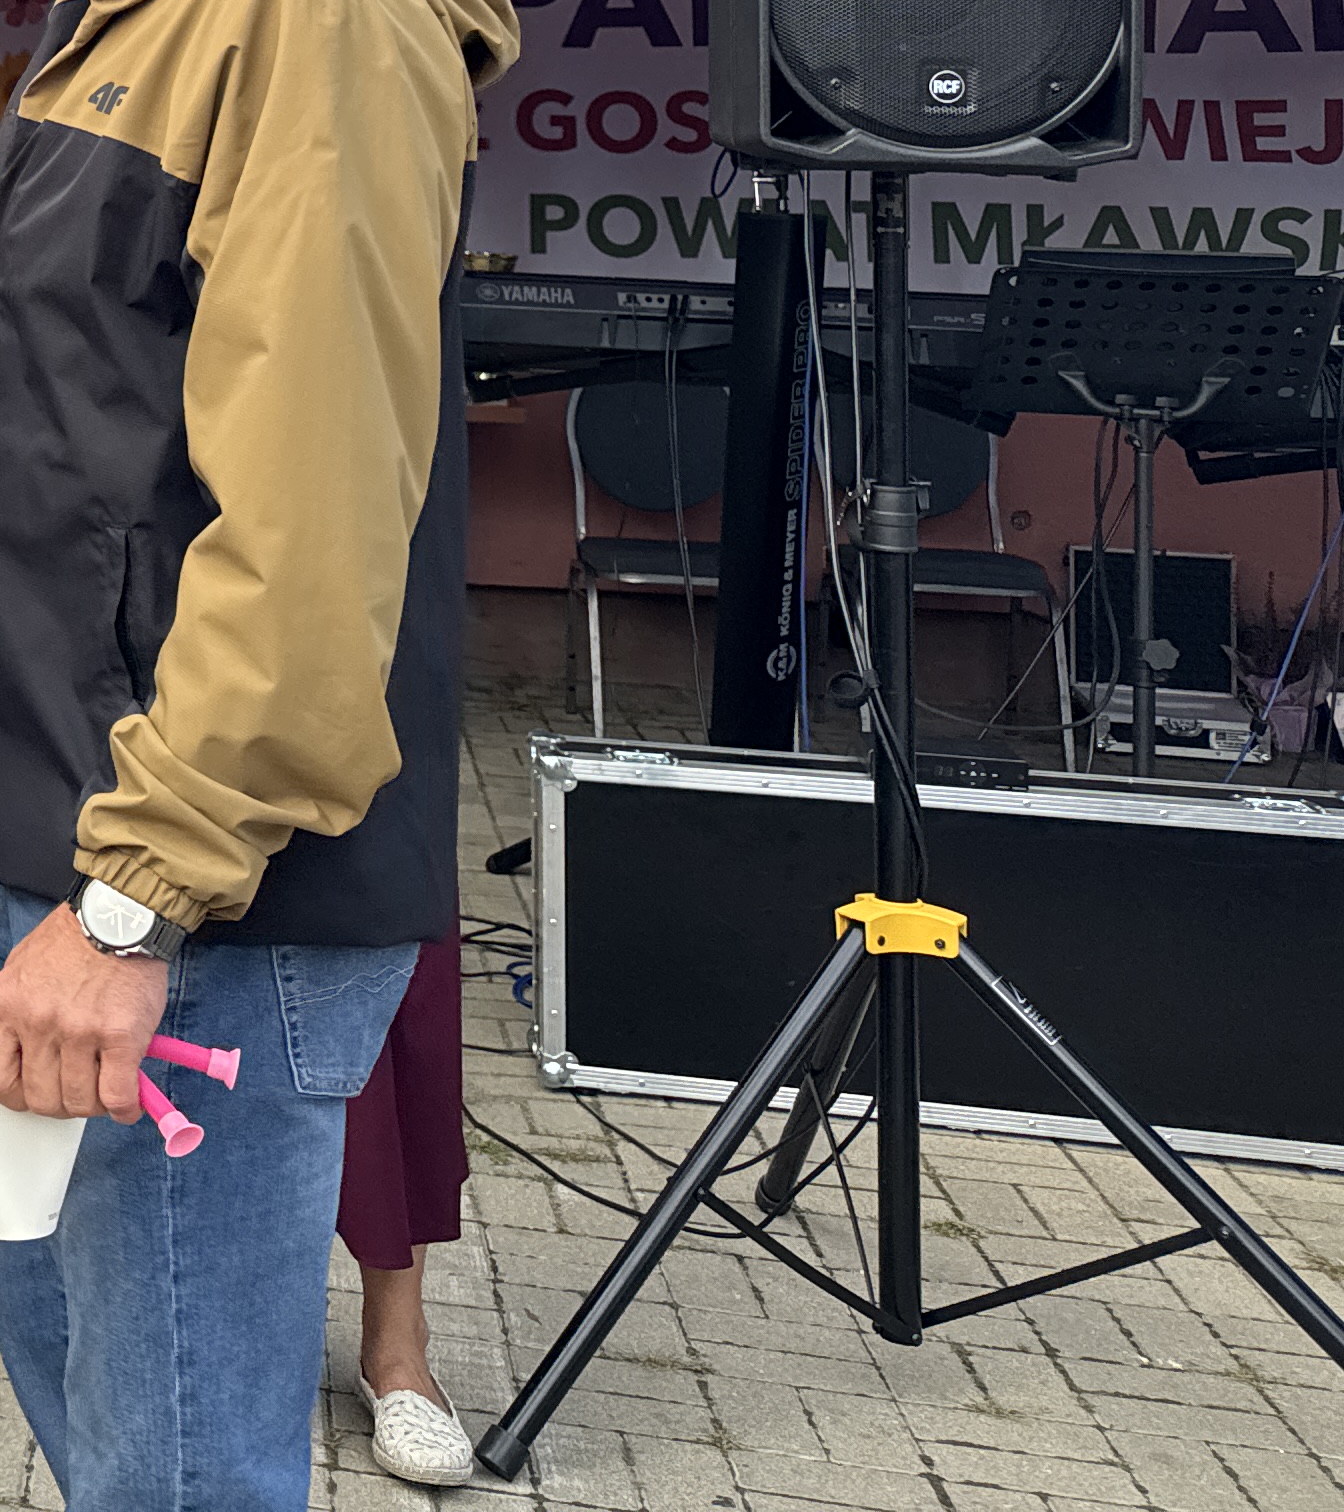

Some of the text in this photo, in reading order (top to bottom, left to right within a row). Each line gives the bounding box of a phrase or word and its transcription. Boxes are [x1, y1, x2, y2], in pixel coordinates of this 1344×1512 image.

[88, 81, 130, 115] 4F
[933, 79, 961, 94] RCF
[501, 284, 575, 305] YAMAHA
[785, 379, 809, 500] SPIDER
[778, 508, 798, 637] KÖNIG & MEYER
[776, 642, 790, 681] K&M
